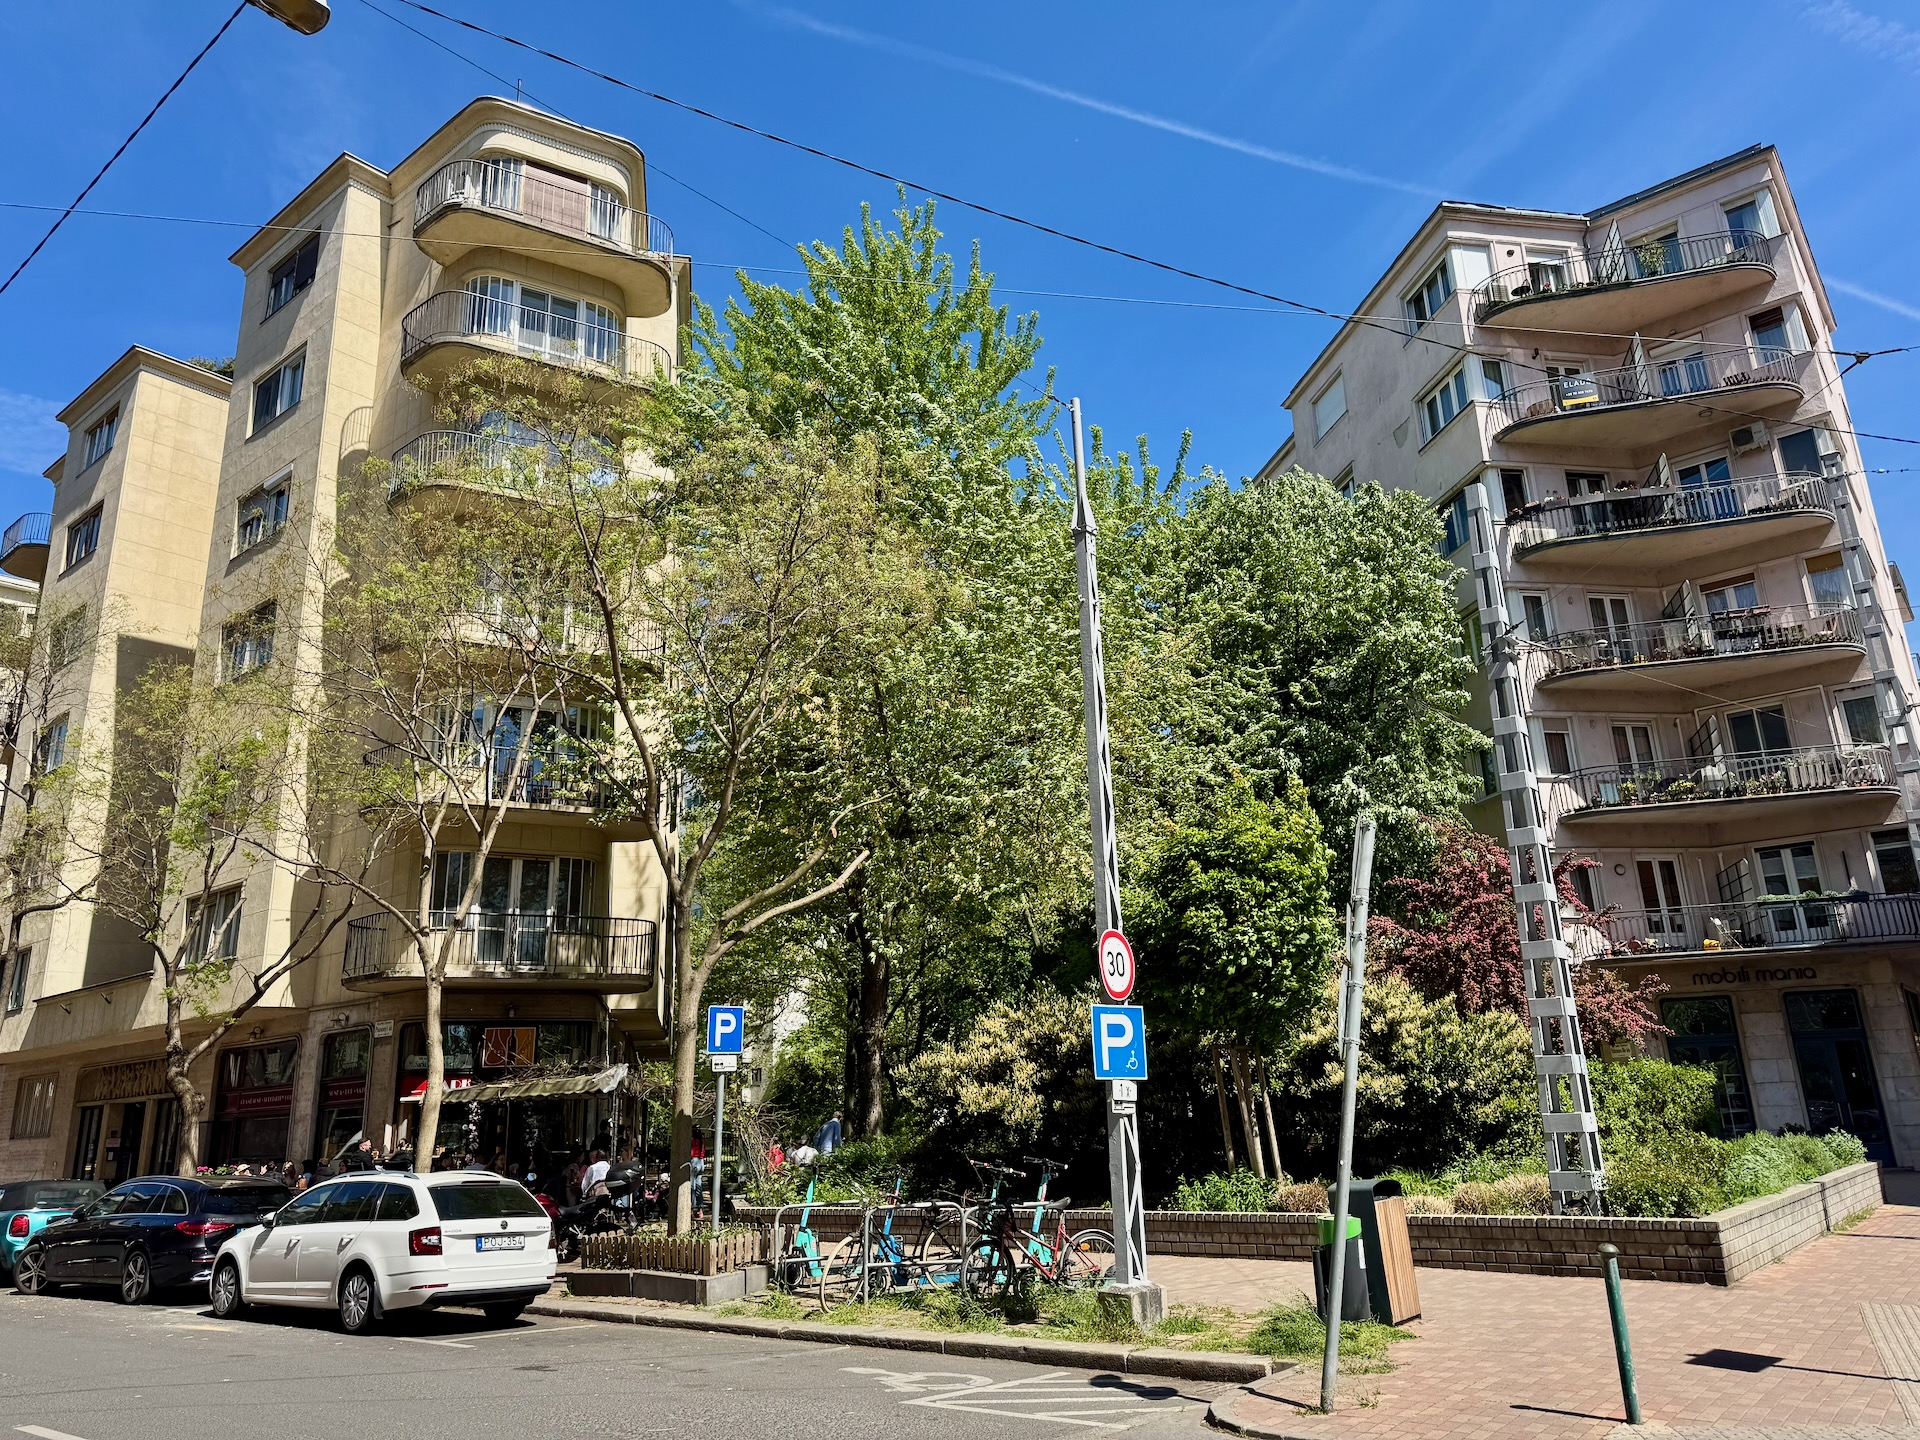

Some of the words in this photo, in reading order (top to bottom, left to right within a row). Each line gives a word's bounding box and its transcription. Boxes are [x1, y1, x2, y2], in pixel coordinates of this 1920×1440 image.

[1107, 951, 1125, 977] 30
[1692, 965, 1750, 985] mobili
[1756, 967, 1817, 982] mania
[715, 1013, 736, 1047] P
[1100, 1013, 1134, 1071] P
[483, 1236, 523, 1247] POJ-354
